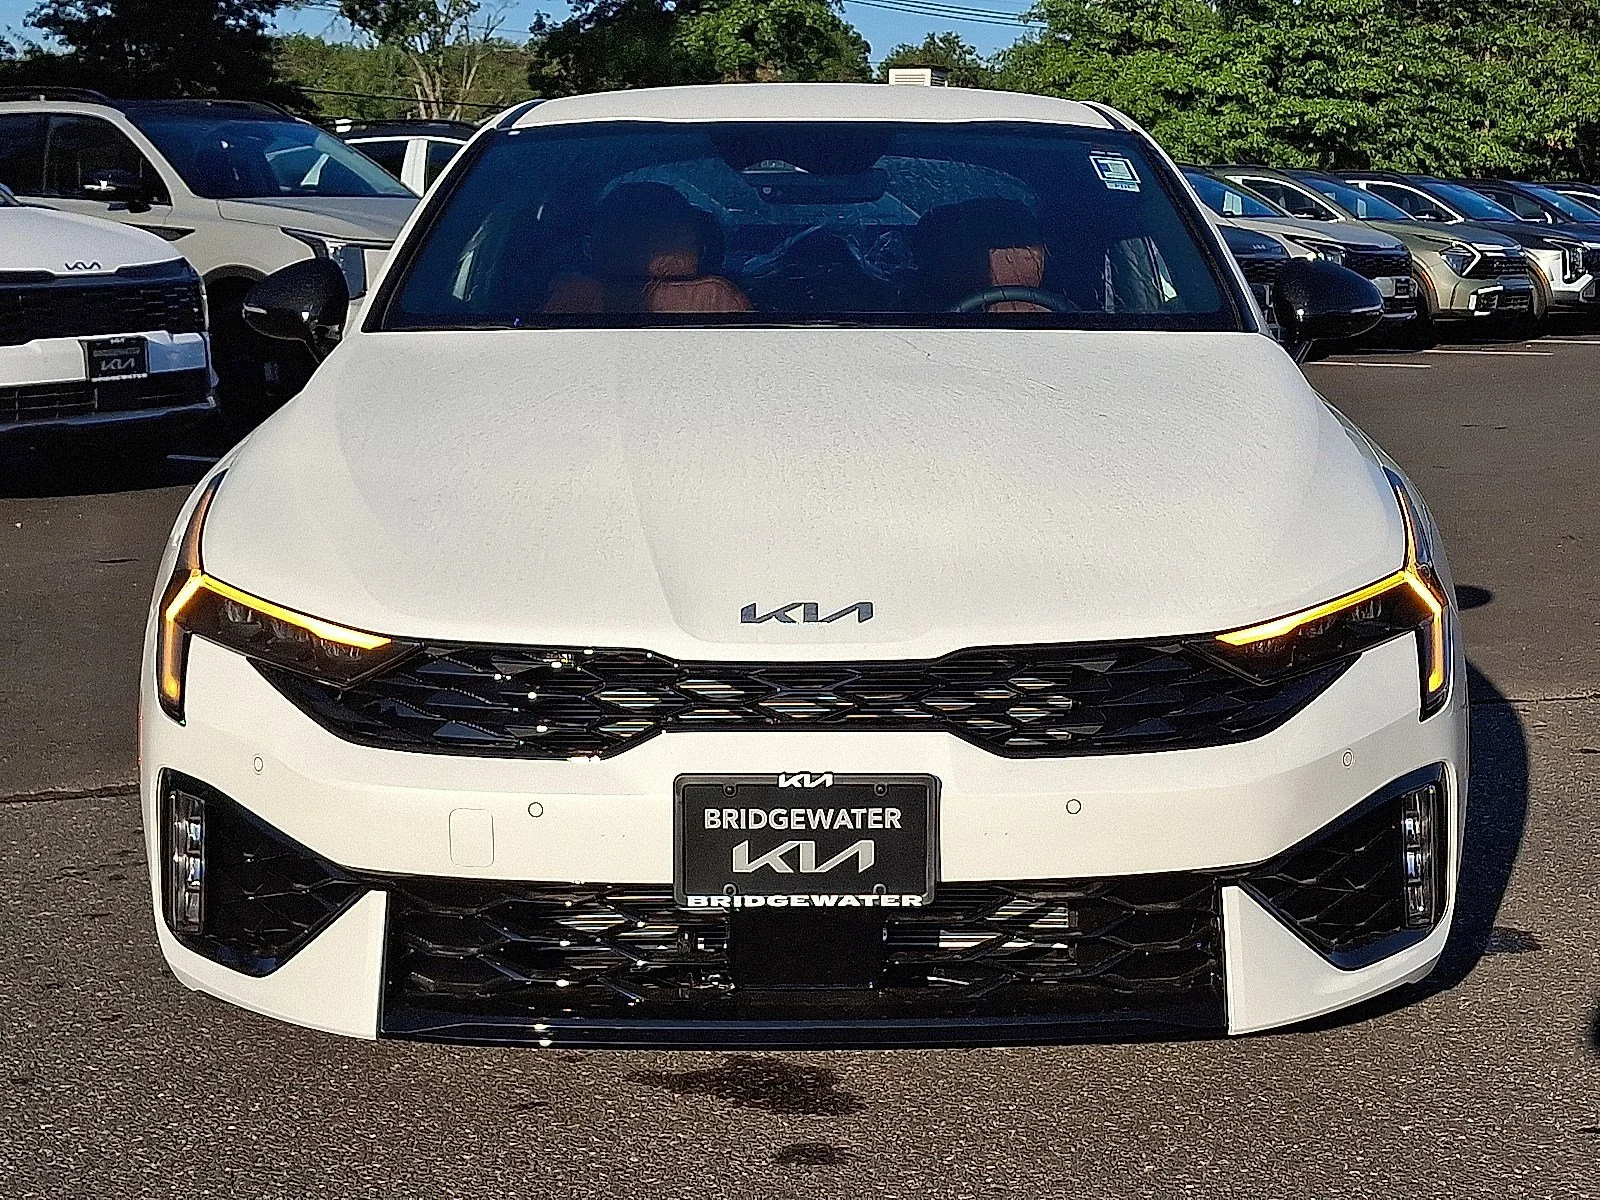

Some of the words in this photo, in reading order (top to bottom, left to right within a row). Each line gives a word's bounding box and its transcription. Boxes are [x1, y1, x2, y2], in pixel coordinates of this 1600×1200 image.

[740, 602, 874, 623] KIA
[778, 772, 833, 788] KIA
[704, 808, 902, 830] BRIDGEWATER
[732, 840, 875, 873] KIA
[687, 894, 923, 908] BRIDGEWATER
